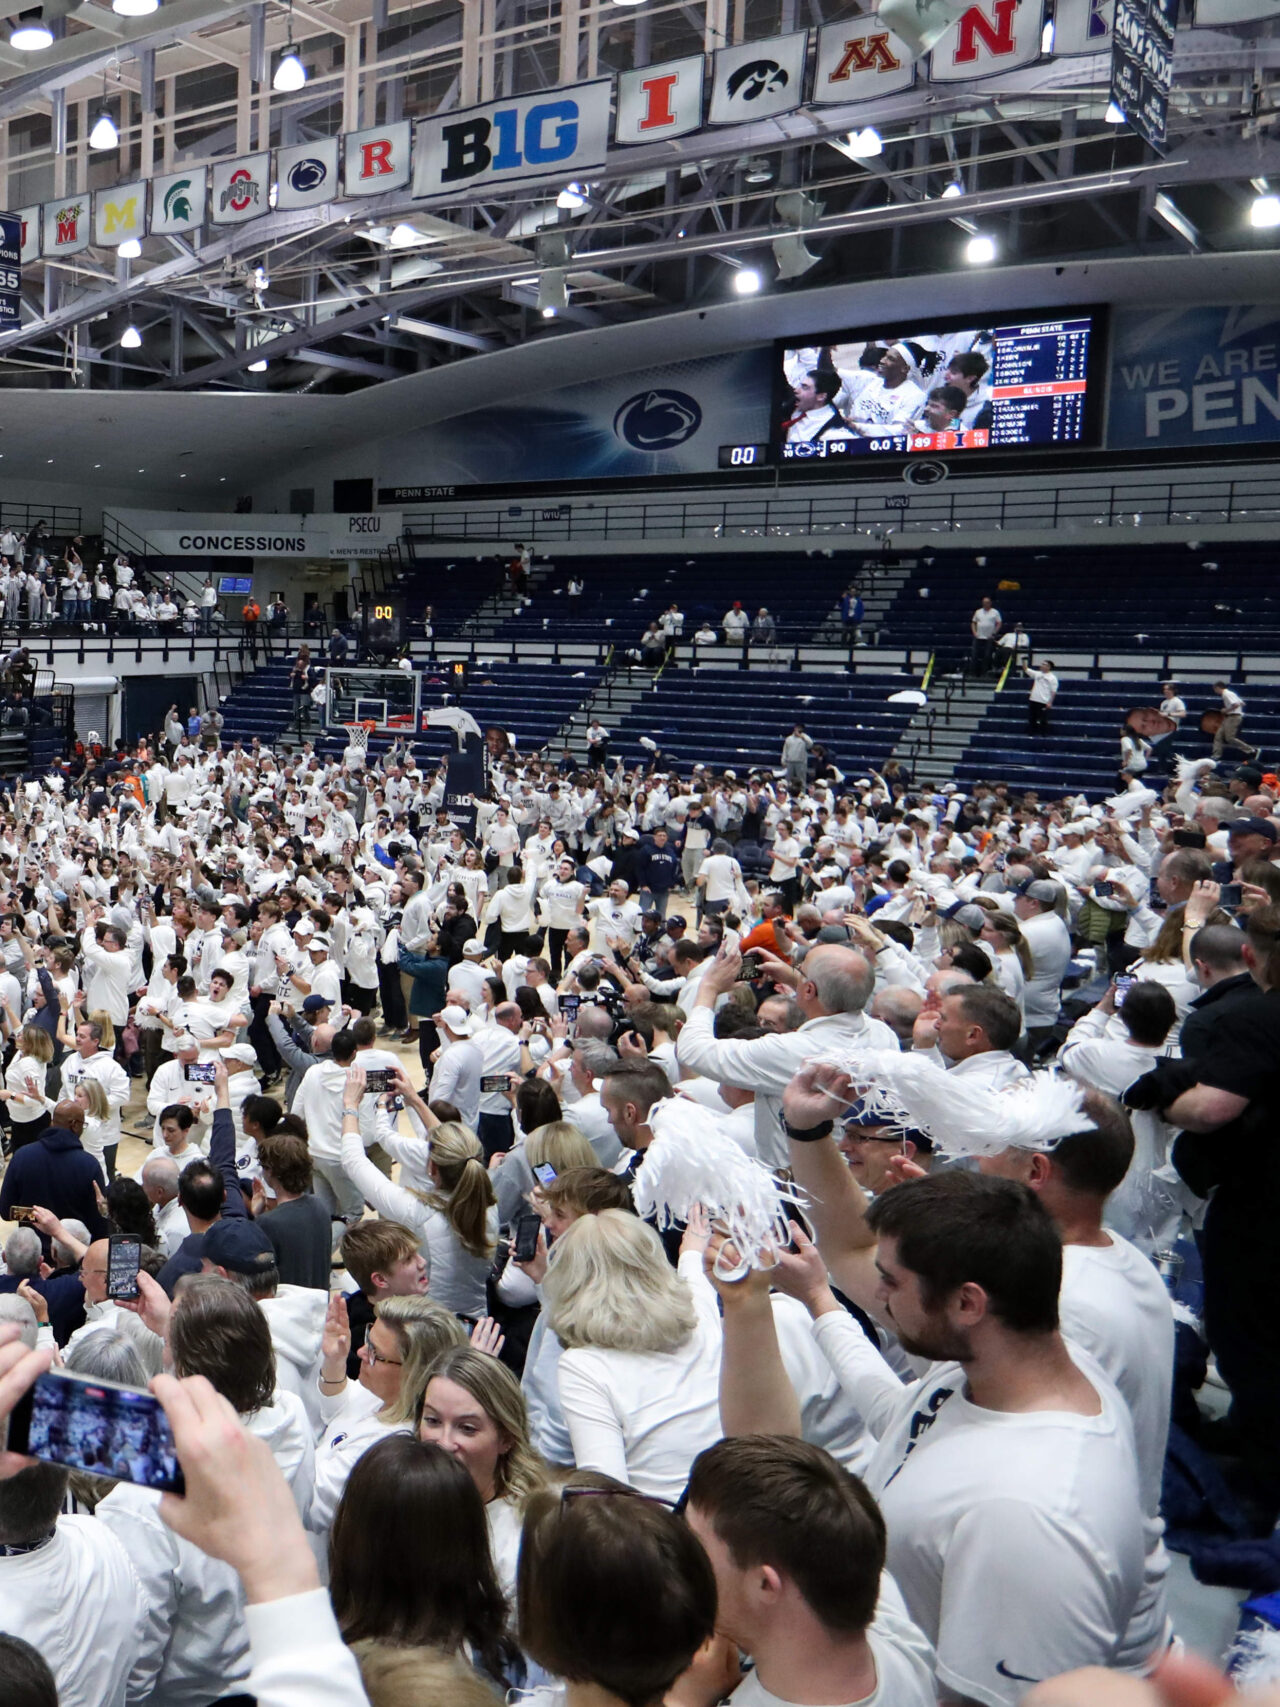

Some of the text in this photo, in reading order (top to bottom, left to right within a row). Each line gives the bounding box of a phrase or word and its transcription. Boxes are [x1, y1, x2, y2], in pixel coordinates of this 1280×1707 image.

[953, 0, 1020, 66] N
[828, 32, 900, 83] M
[638, 72, 677, 132] I
[360, 140, 397, 178] R
[104, 198, 137, 233] M
[1042, 324, 1063, 333] STATE
[1121, 344, 1277, 390] WE ARE
[830, 443, 846, 453] 90
[870, 439, 891, 451] 0.0
[914, 438, 931, 448] 89
[783, 449, 794, 458] 10
[395, 486, 455, 498] PENN STATE
[349, 517, 381, 533] PSECU
[179, 535, 306, 552] CONCESSIONS
